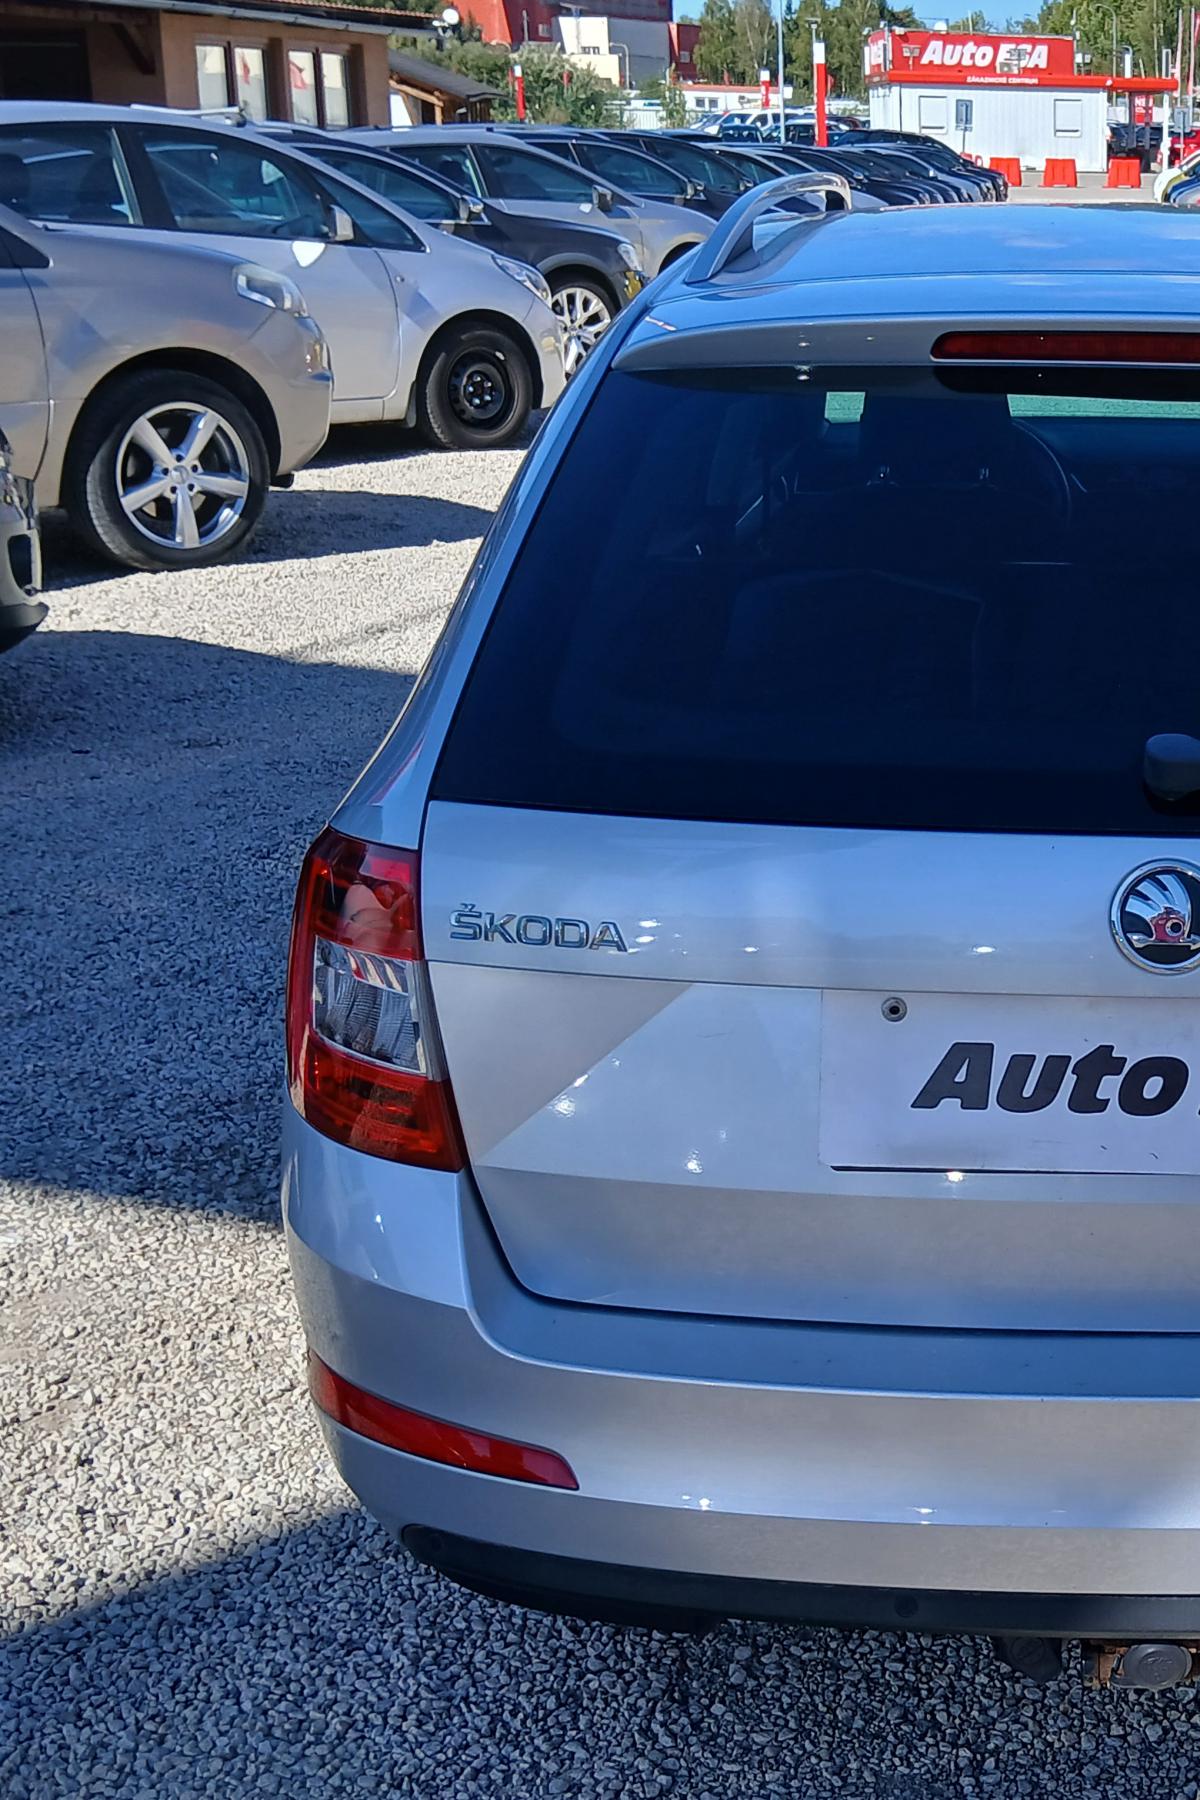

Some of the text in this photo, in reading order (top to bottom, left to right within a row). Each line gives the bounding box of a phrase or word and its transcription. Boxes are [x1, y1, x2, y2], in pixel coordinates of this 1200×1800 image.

[920, 40, 994, 68] Auto
[450, 902, 628, 952] ŠKODA
[910, 1042, 1190, 1117] Auto
